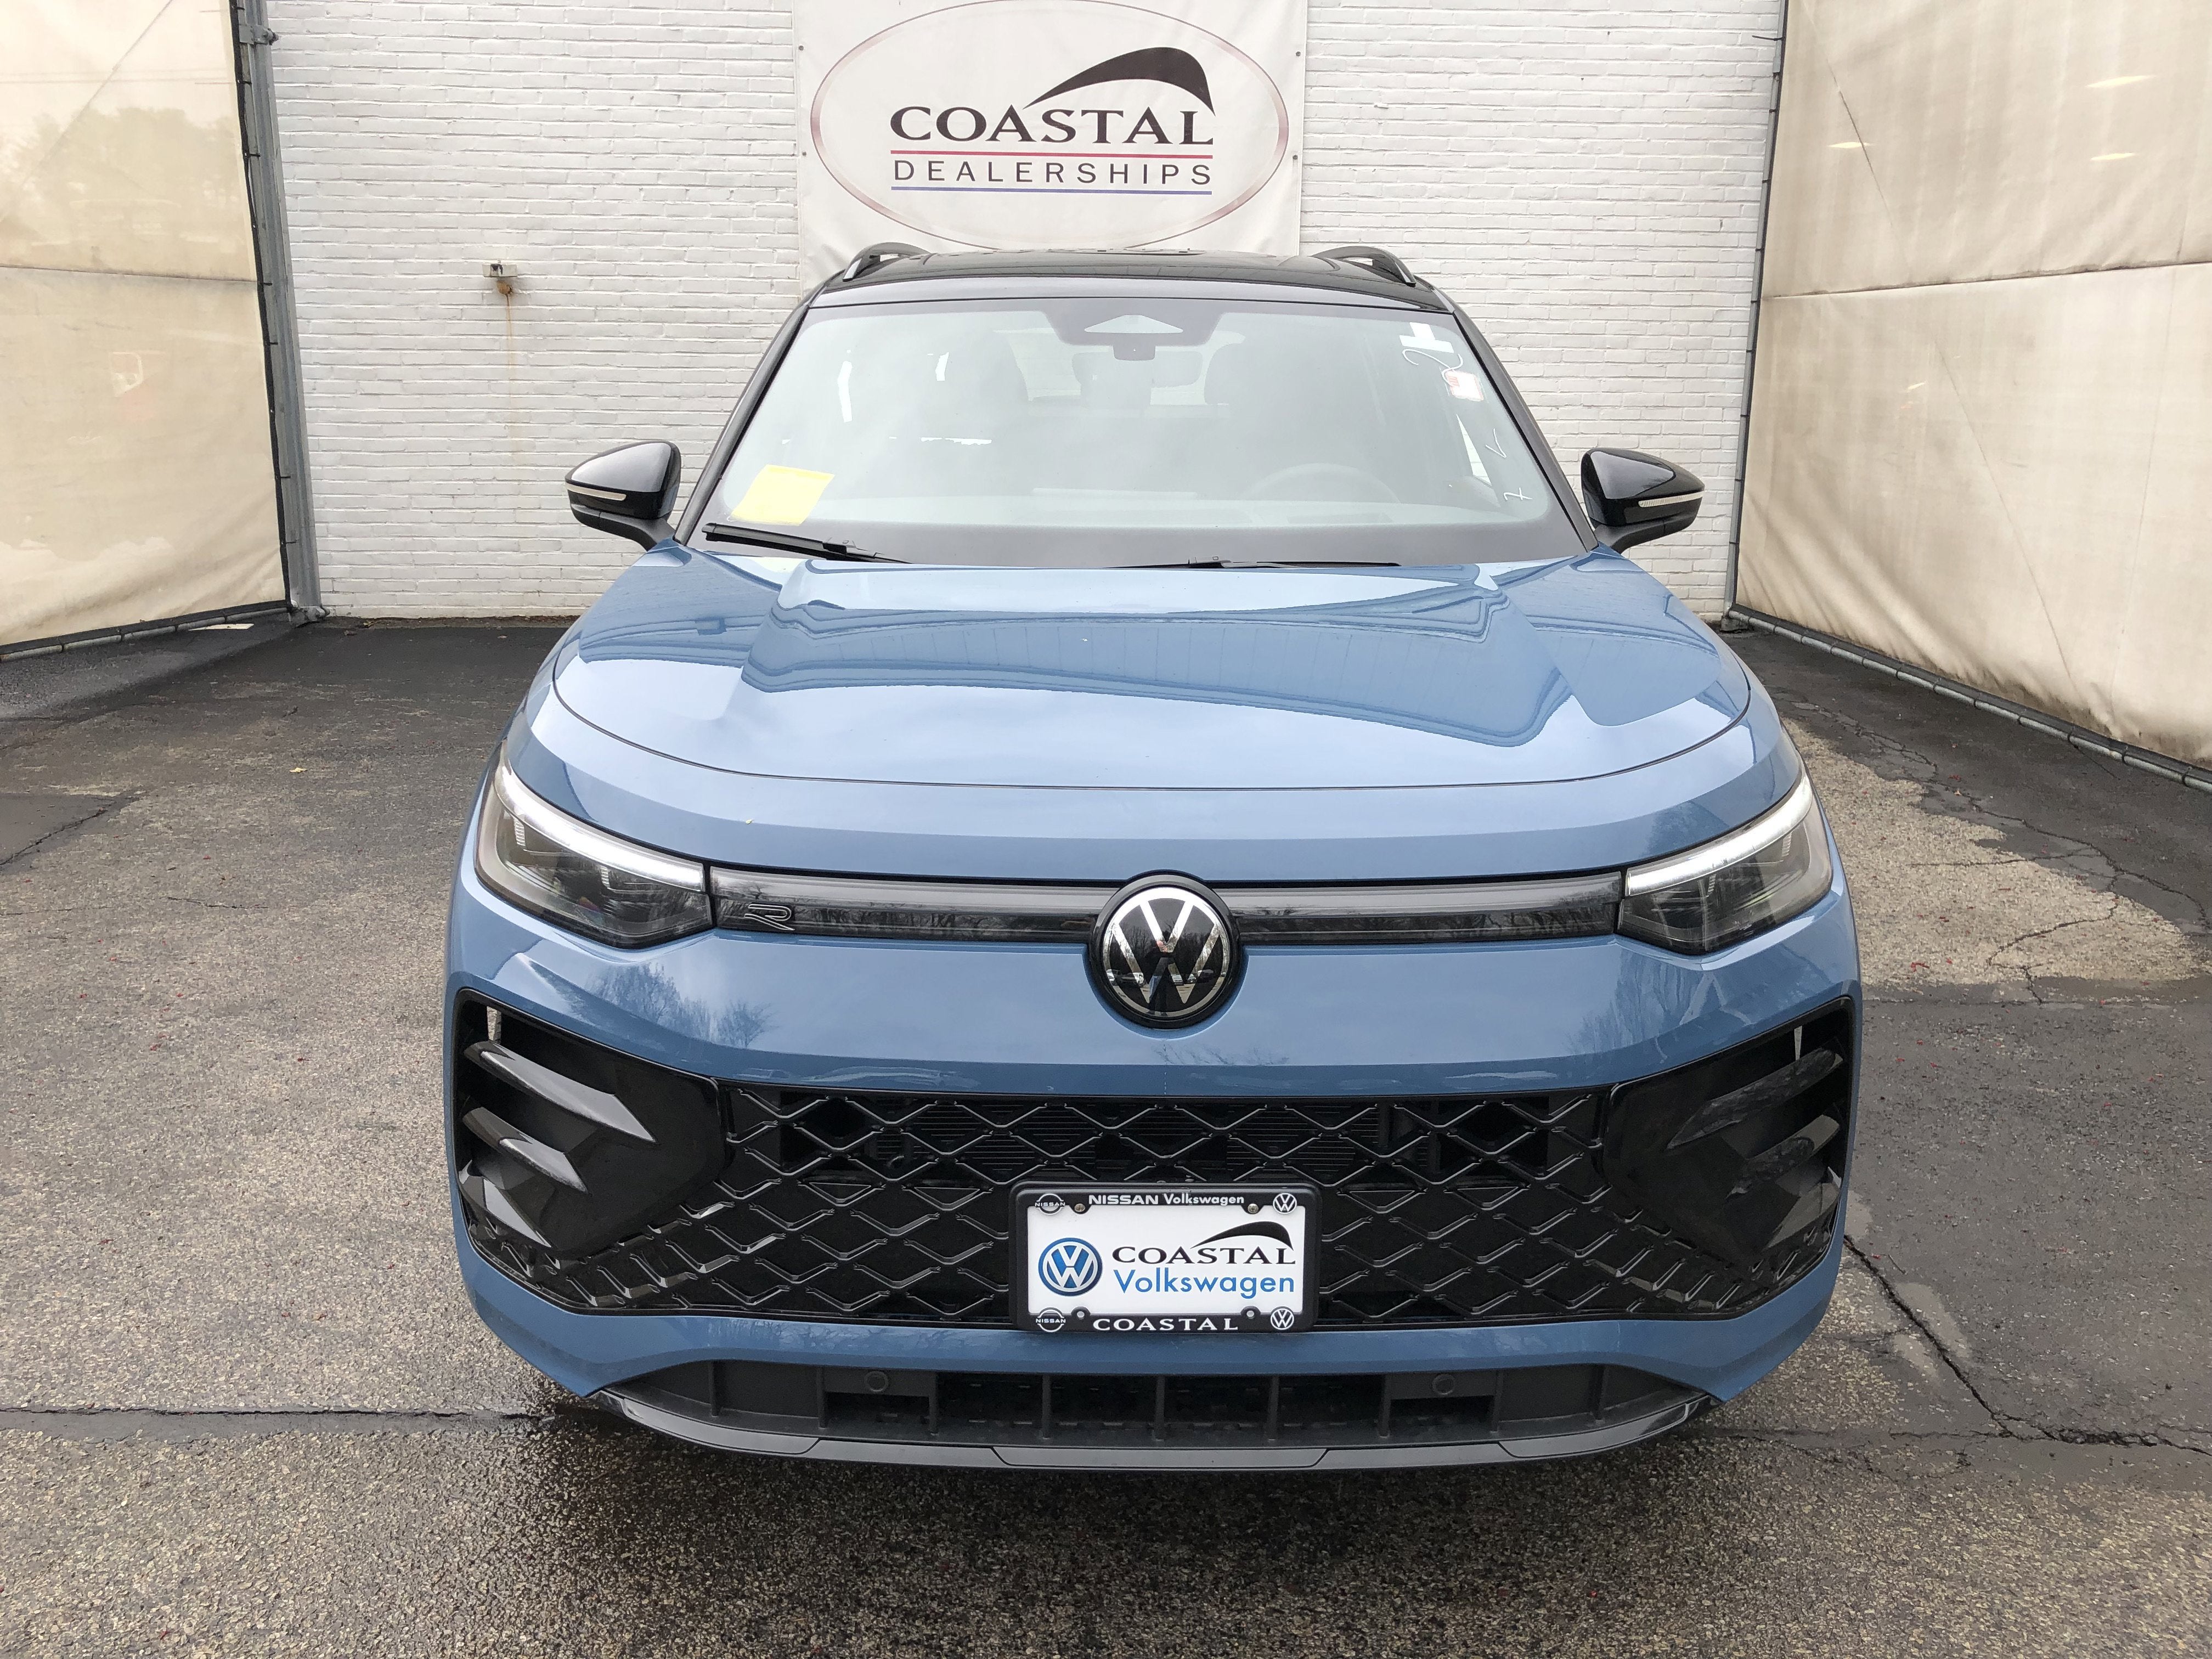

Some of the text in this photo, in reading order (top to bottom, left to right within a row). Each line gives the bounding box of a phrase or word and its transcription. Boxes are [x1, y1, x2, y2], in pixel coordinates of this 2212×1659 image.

[890, 104, 1213, 145] COASTAL
[894, 160, 1210, 185] DEALERSHIPS
[1088, 1193, 1244, 1205] NISSAN Volkswagen
[1112, 1246, 1296, 1265] COASTAL
[1113, 1267, 1294, 1299] Volkswagen
[1093, 1318, 1238, 1331] COASTAL
